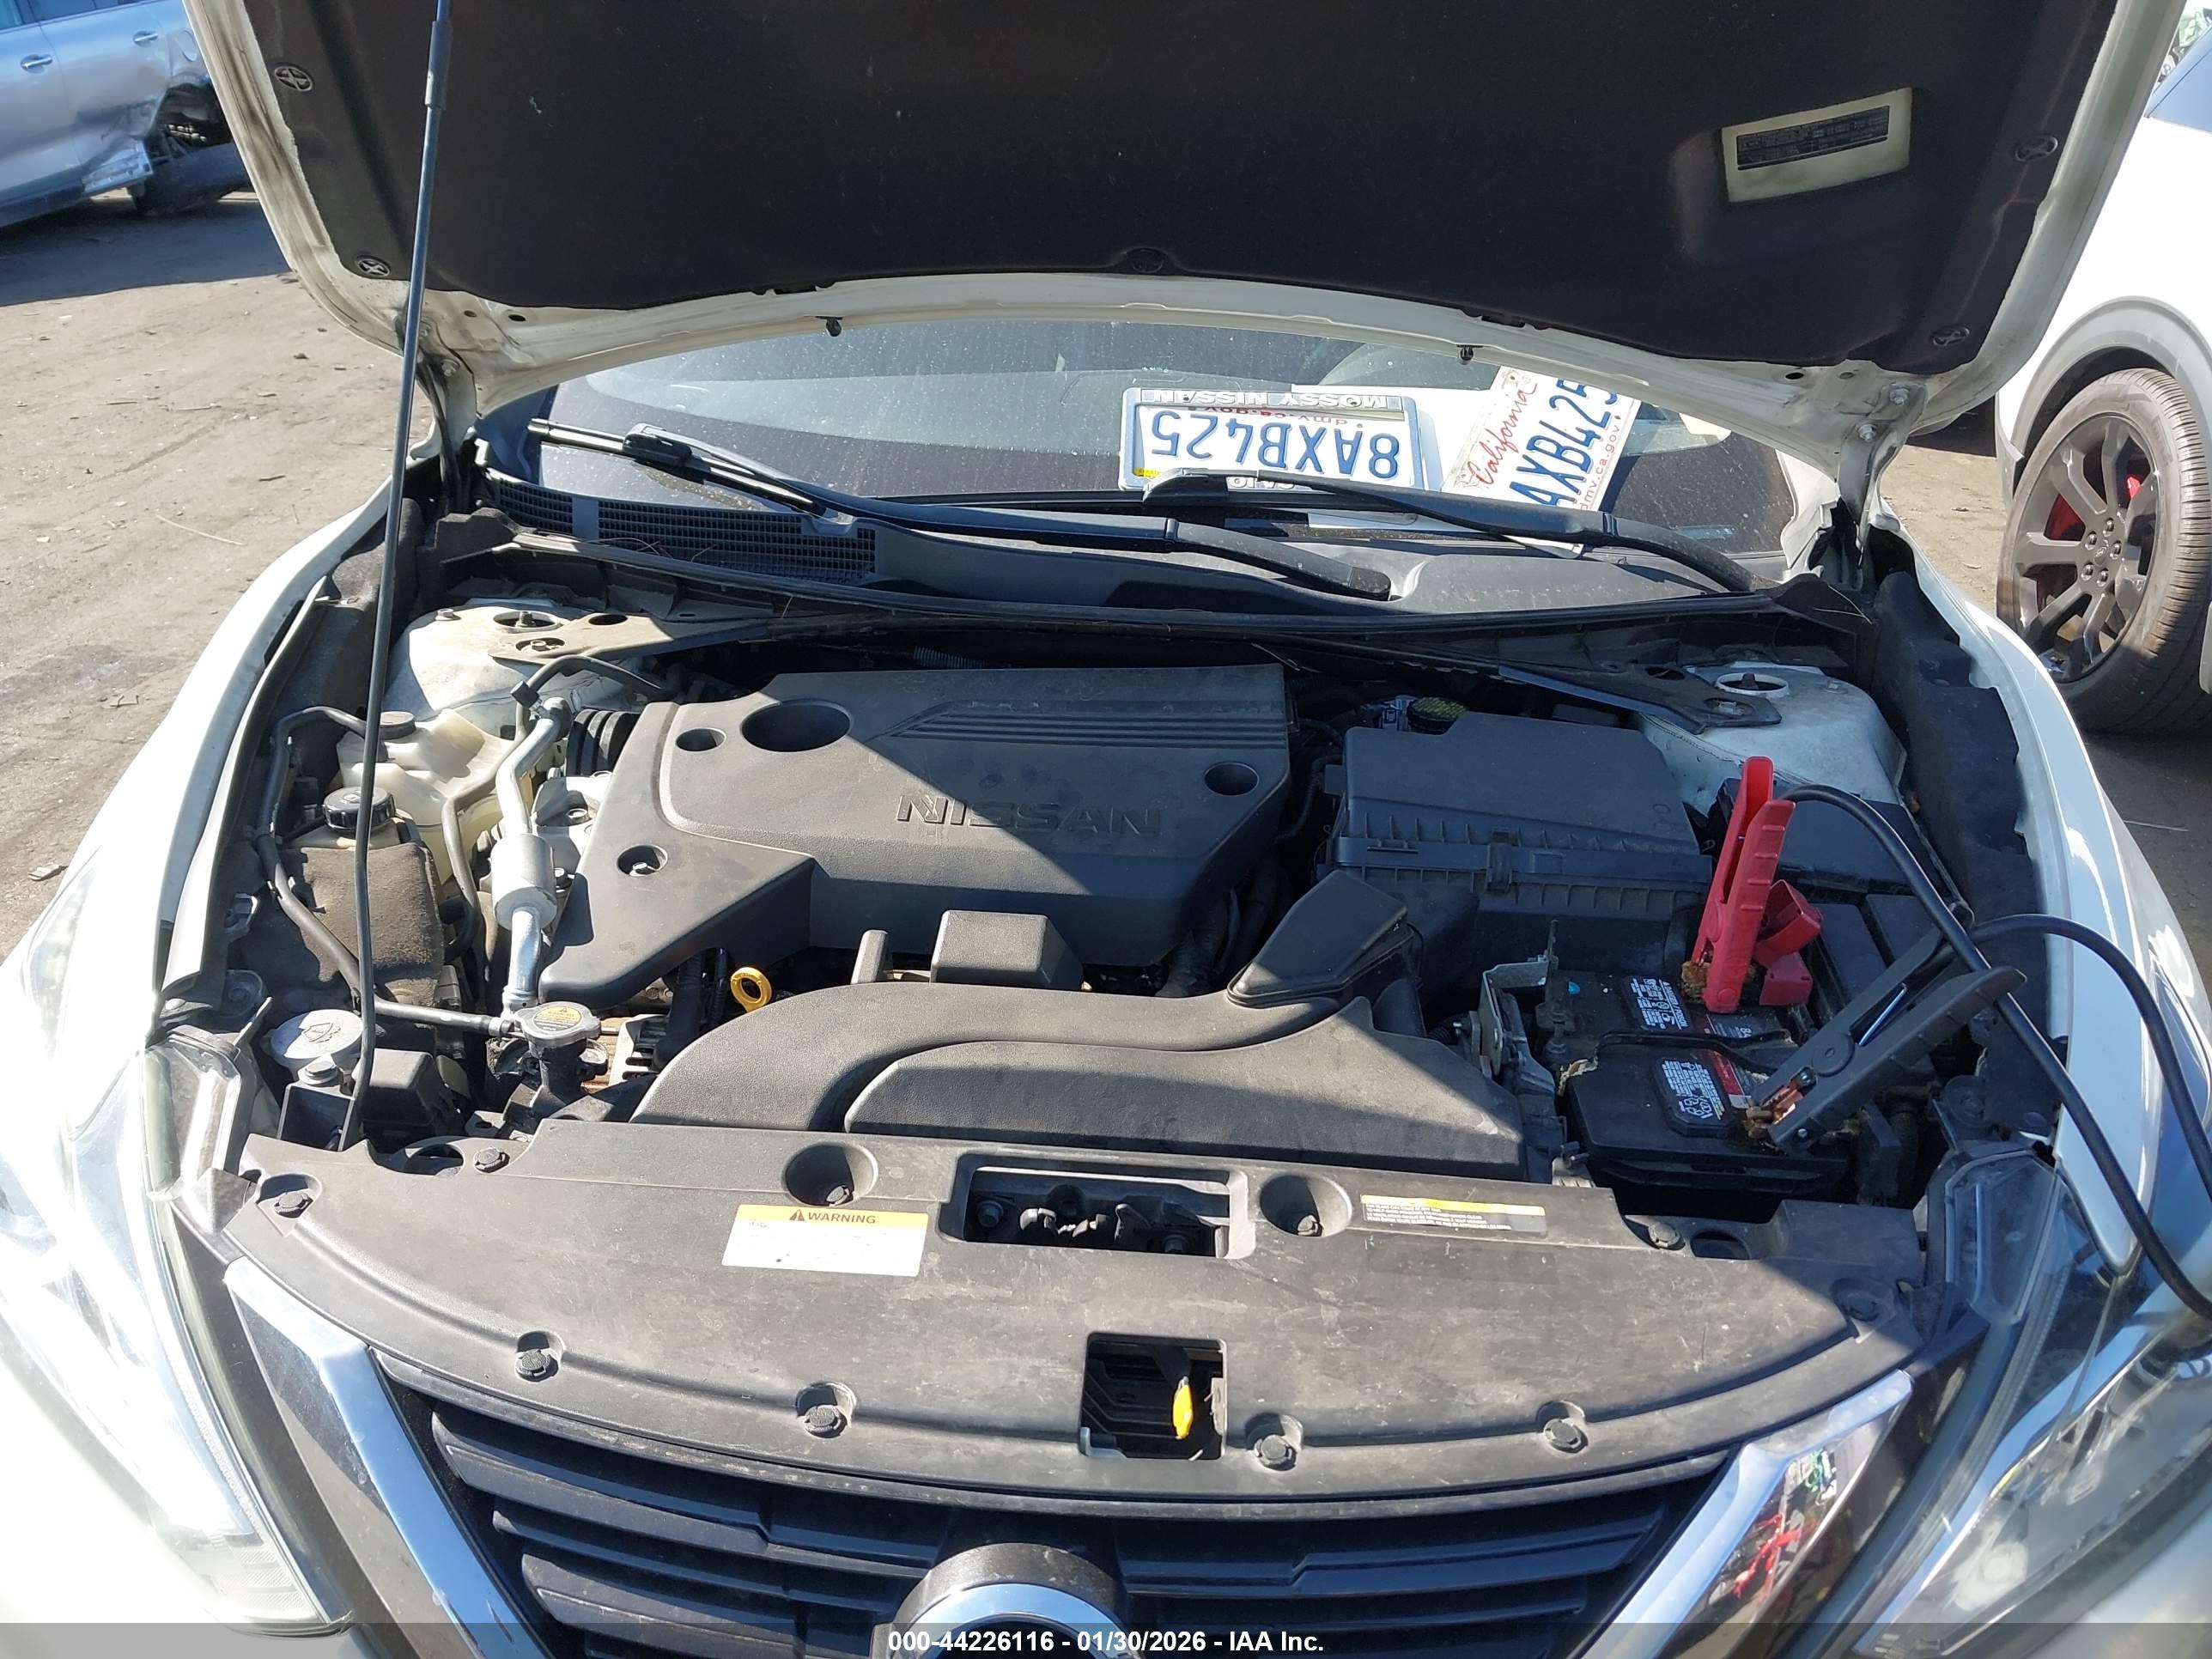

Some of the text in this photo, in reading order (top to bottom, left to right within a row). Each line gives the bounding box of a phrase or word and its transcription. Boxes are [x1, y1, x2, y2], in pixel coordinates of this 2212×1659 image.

[1153, 389, 1388, 409] MOSSY NISSAN
[1151, 410, 1401, 479] 8AXB425
[1467, 382, 1538, 485] California
[896, 795, 1158, 834] NISSAN
[808, 1212, 876, 1224] WARNING
